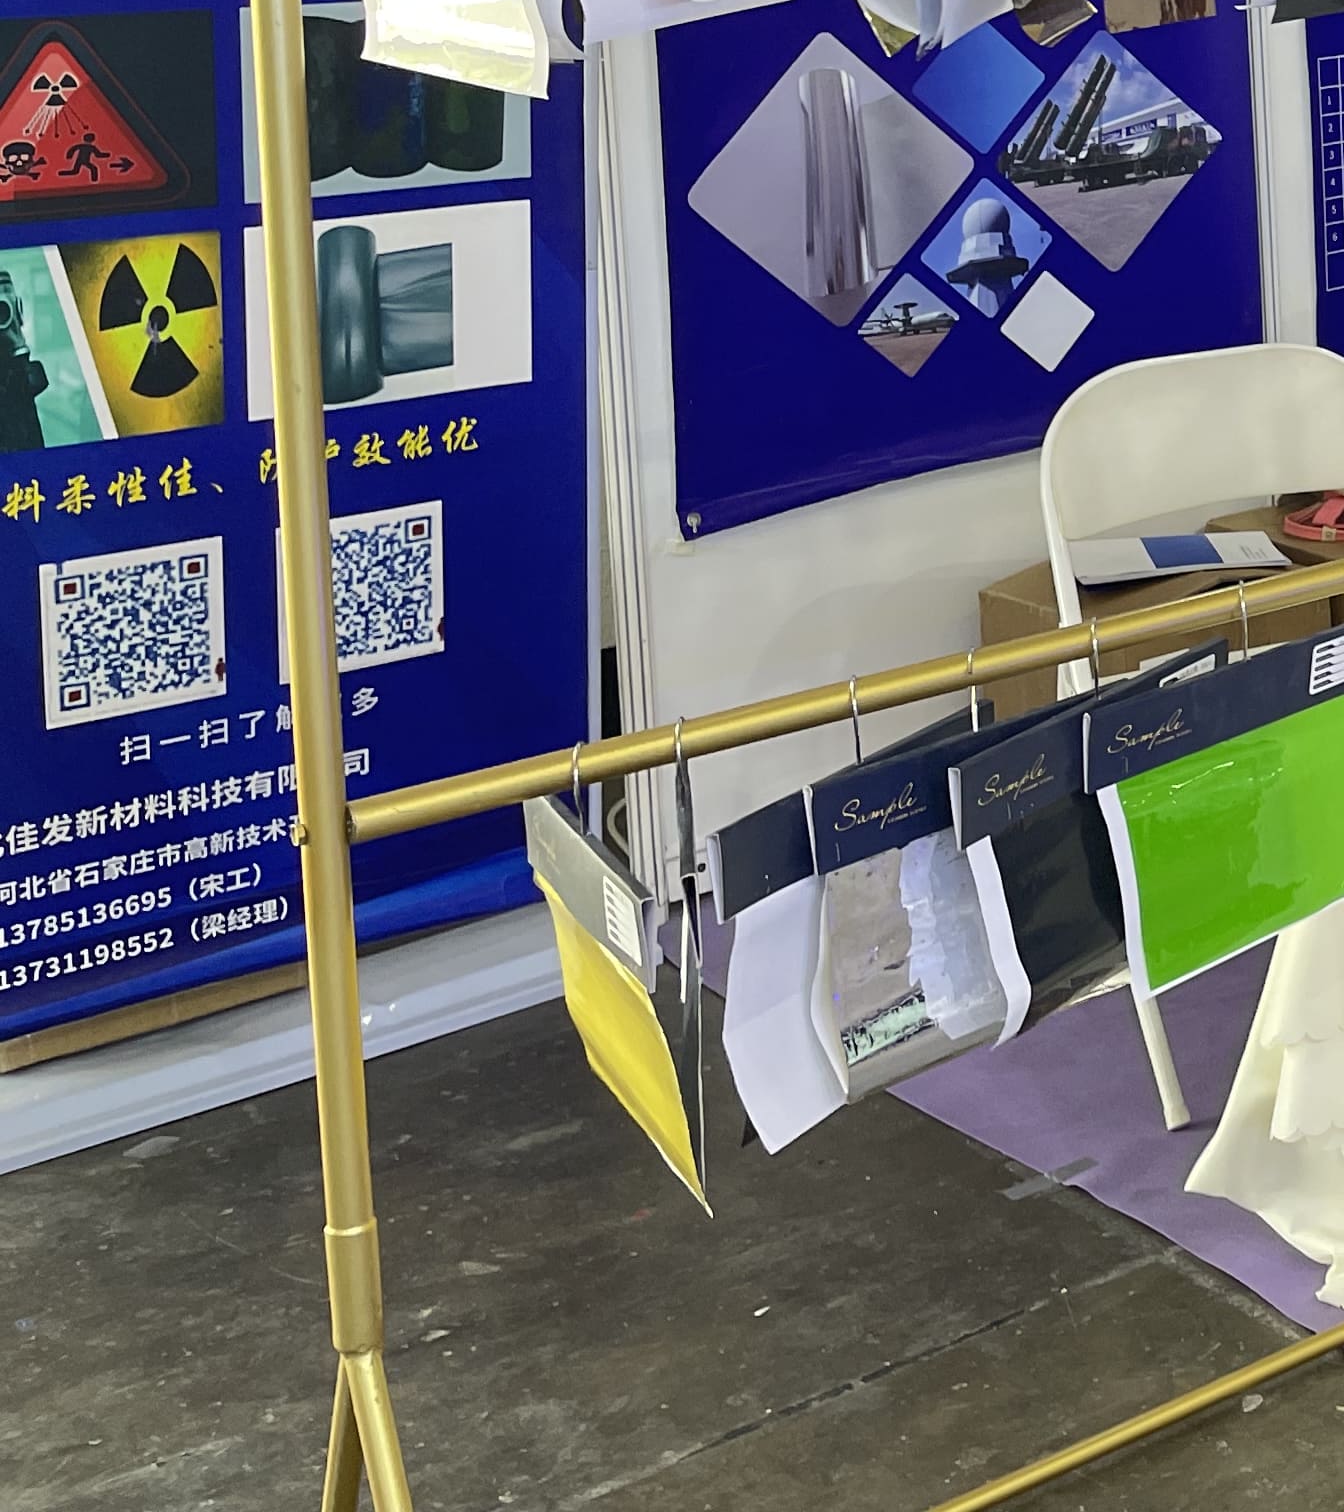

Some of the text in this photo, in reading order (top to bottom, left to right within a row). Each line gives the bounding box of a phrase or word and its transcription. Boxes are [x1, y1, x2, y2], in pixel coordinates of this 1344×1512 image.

[1106, 708, 1185, 755] Sample
[834, 781, 919, 833] Sample
[977, 753, 1047, 808] Sample
[0, 862, 262, 949] 13785136695 （宋工）
[0, 896, 289, 990] 13731198552 （梁经理）
